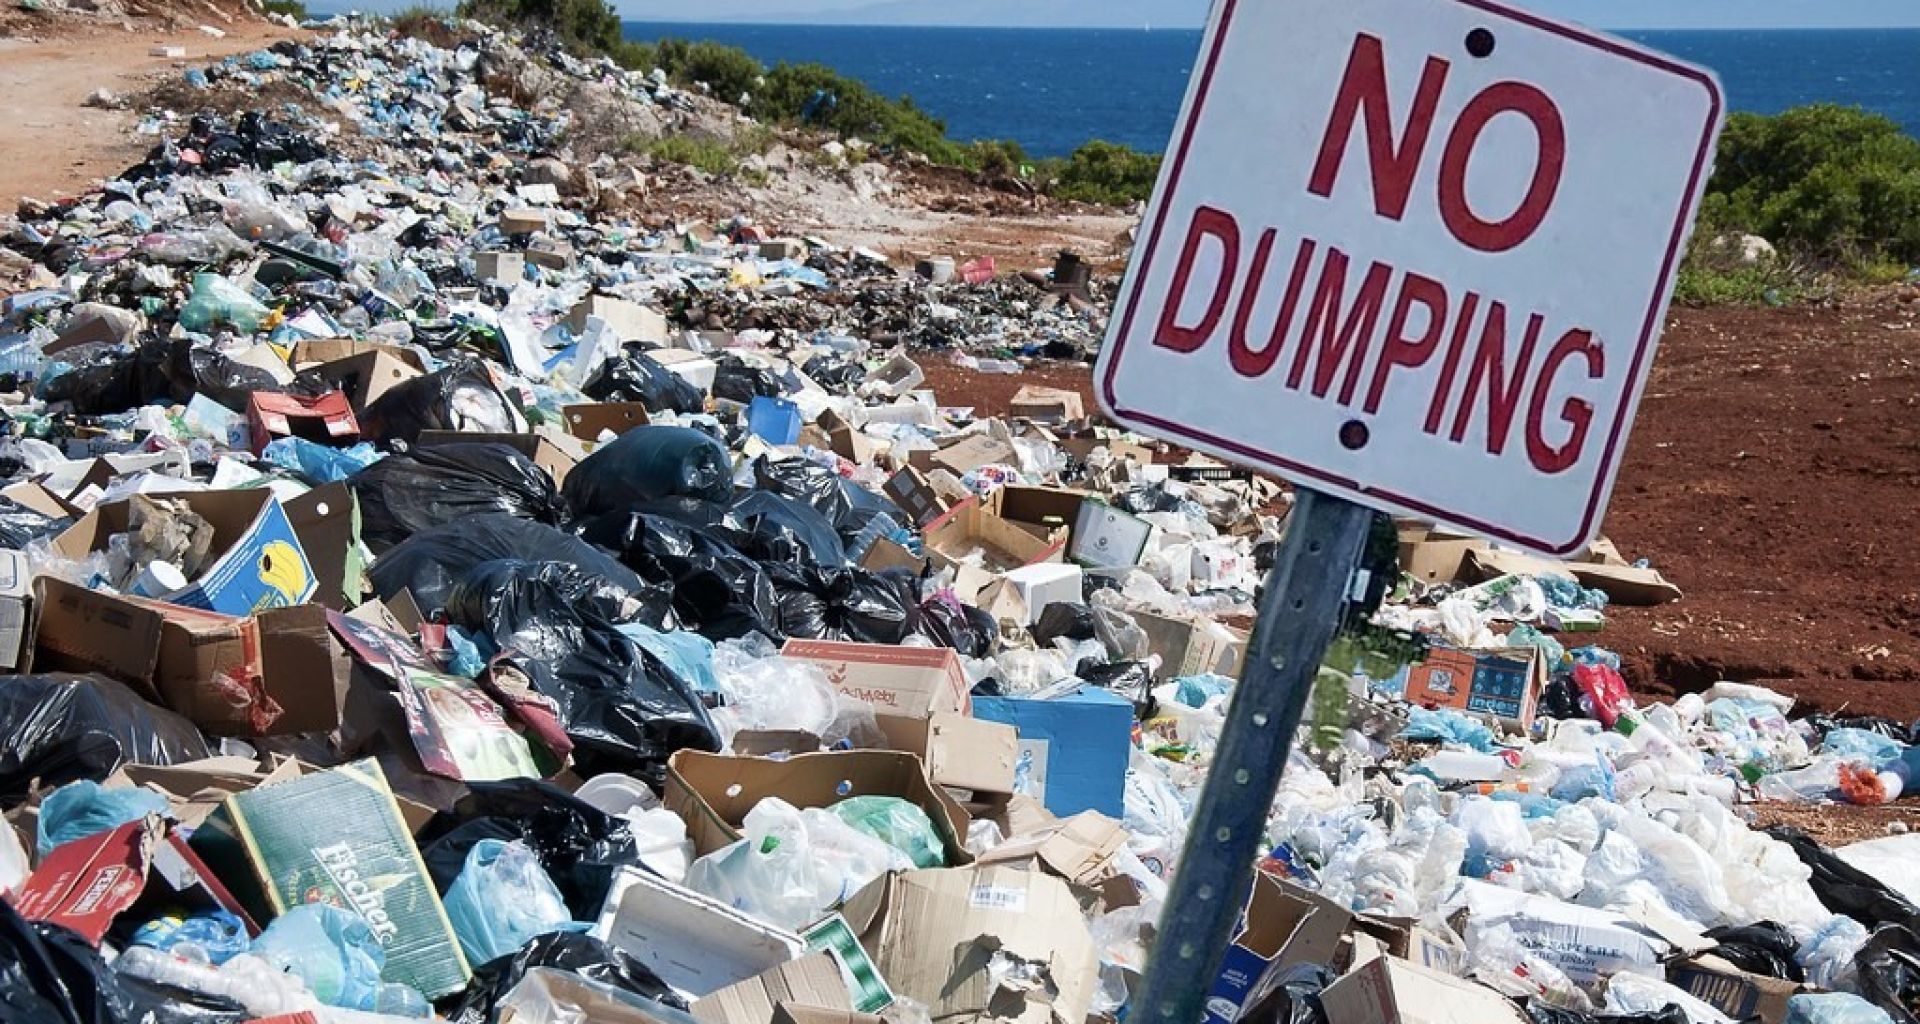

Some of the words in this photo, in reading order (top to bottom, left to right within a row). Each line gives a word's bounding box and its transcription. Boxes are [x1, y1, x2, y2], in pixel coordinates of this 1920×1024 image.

[1307, 31, 1566, 253] NO
[1153, 206, 1605, 474] DUMPING
[313, 841, 397, 944] Fischer
